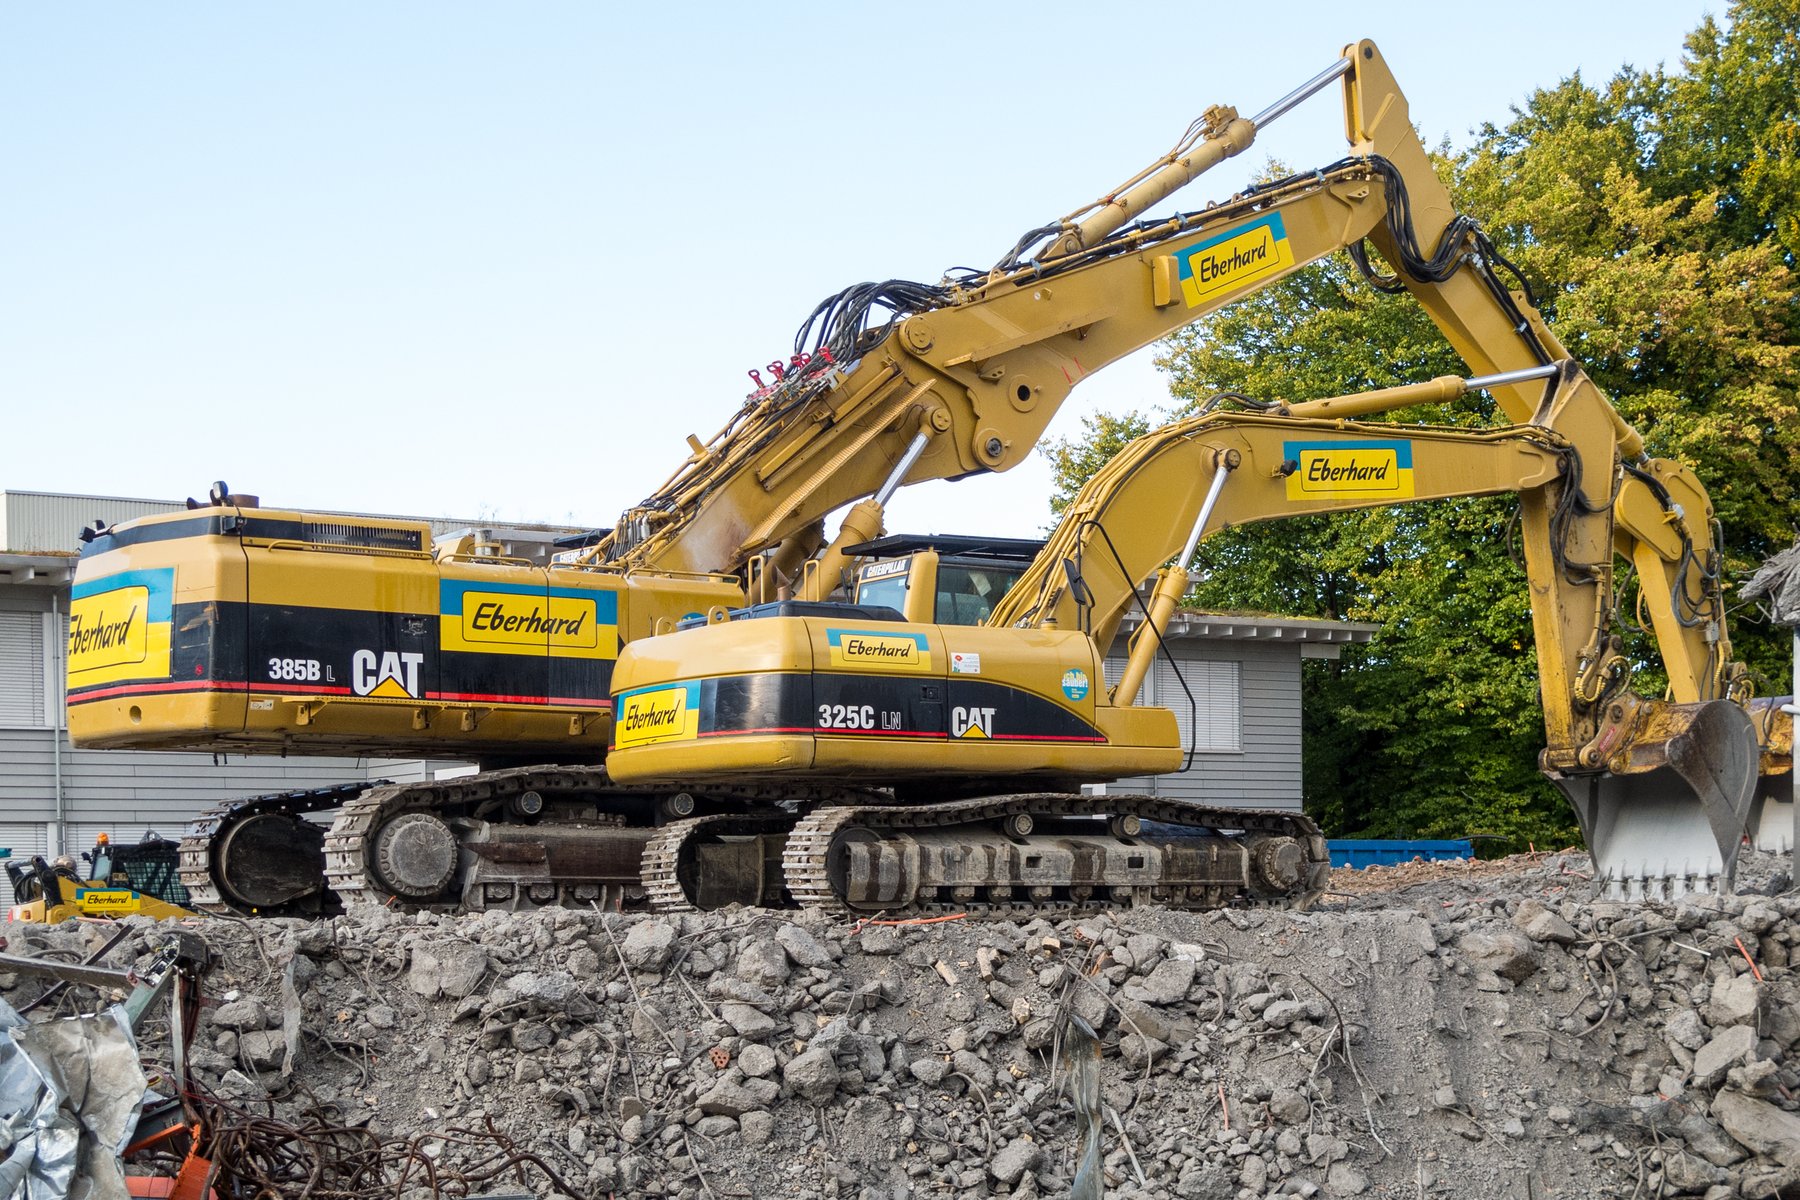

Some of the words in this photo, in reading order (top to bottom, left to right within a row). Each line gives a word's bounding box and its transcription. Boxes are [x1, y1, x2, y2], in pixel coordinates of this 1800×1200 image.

[1200, 236, 1266, 282] Eberhard
[1308, 458, 1391, 482] Eberhard
[867, 559, 907, 578] CATERPILLAR
[472, 602, 587, 636] Eberhard
[847, 638, 912, 657] Eberhard
[268, 657, 321, 681] 385B
[326, 664, 336, 682] L
[352, 649, 424, 699] CAT
[626, 699, 680, 731] Eberhard
[818, 703, 875, 730] 325C
[881, 711, 901, 730] LN
[952, 706, 995, 739] CAT
[88, 894, 128, 904] Eberhard
